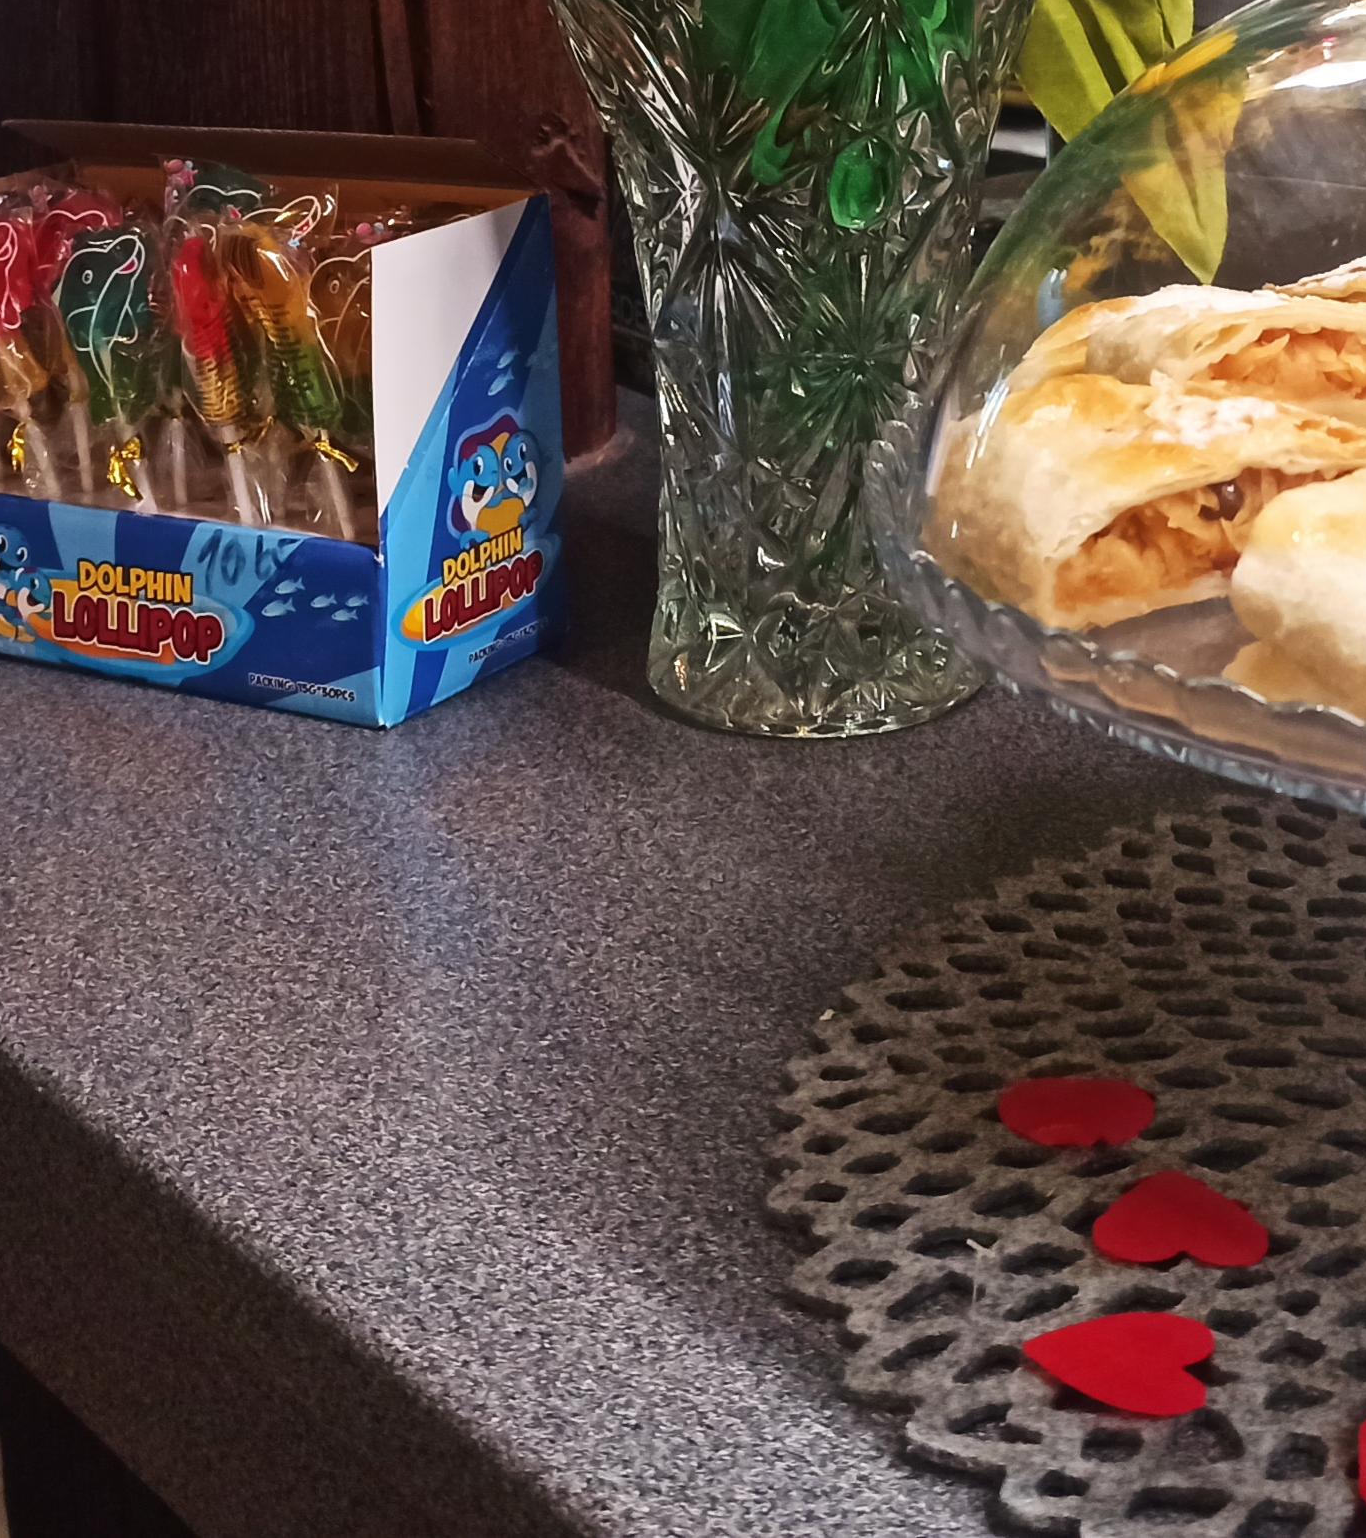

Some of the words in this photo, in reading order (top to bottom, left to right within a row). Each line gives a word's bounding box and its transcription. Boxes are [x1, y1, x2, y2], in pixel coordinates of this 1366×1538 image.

[78, 558, 193, 605] DOLPHIN
[197, 528, 247, 595] 10
[442, 526, 523, 588] DOLPHIN
[51, 588, 224, 665] LOLLIPOP
[423, 548, 544, 644] LOLLIPOP
